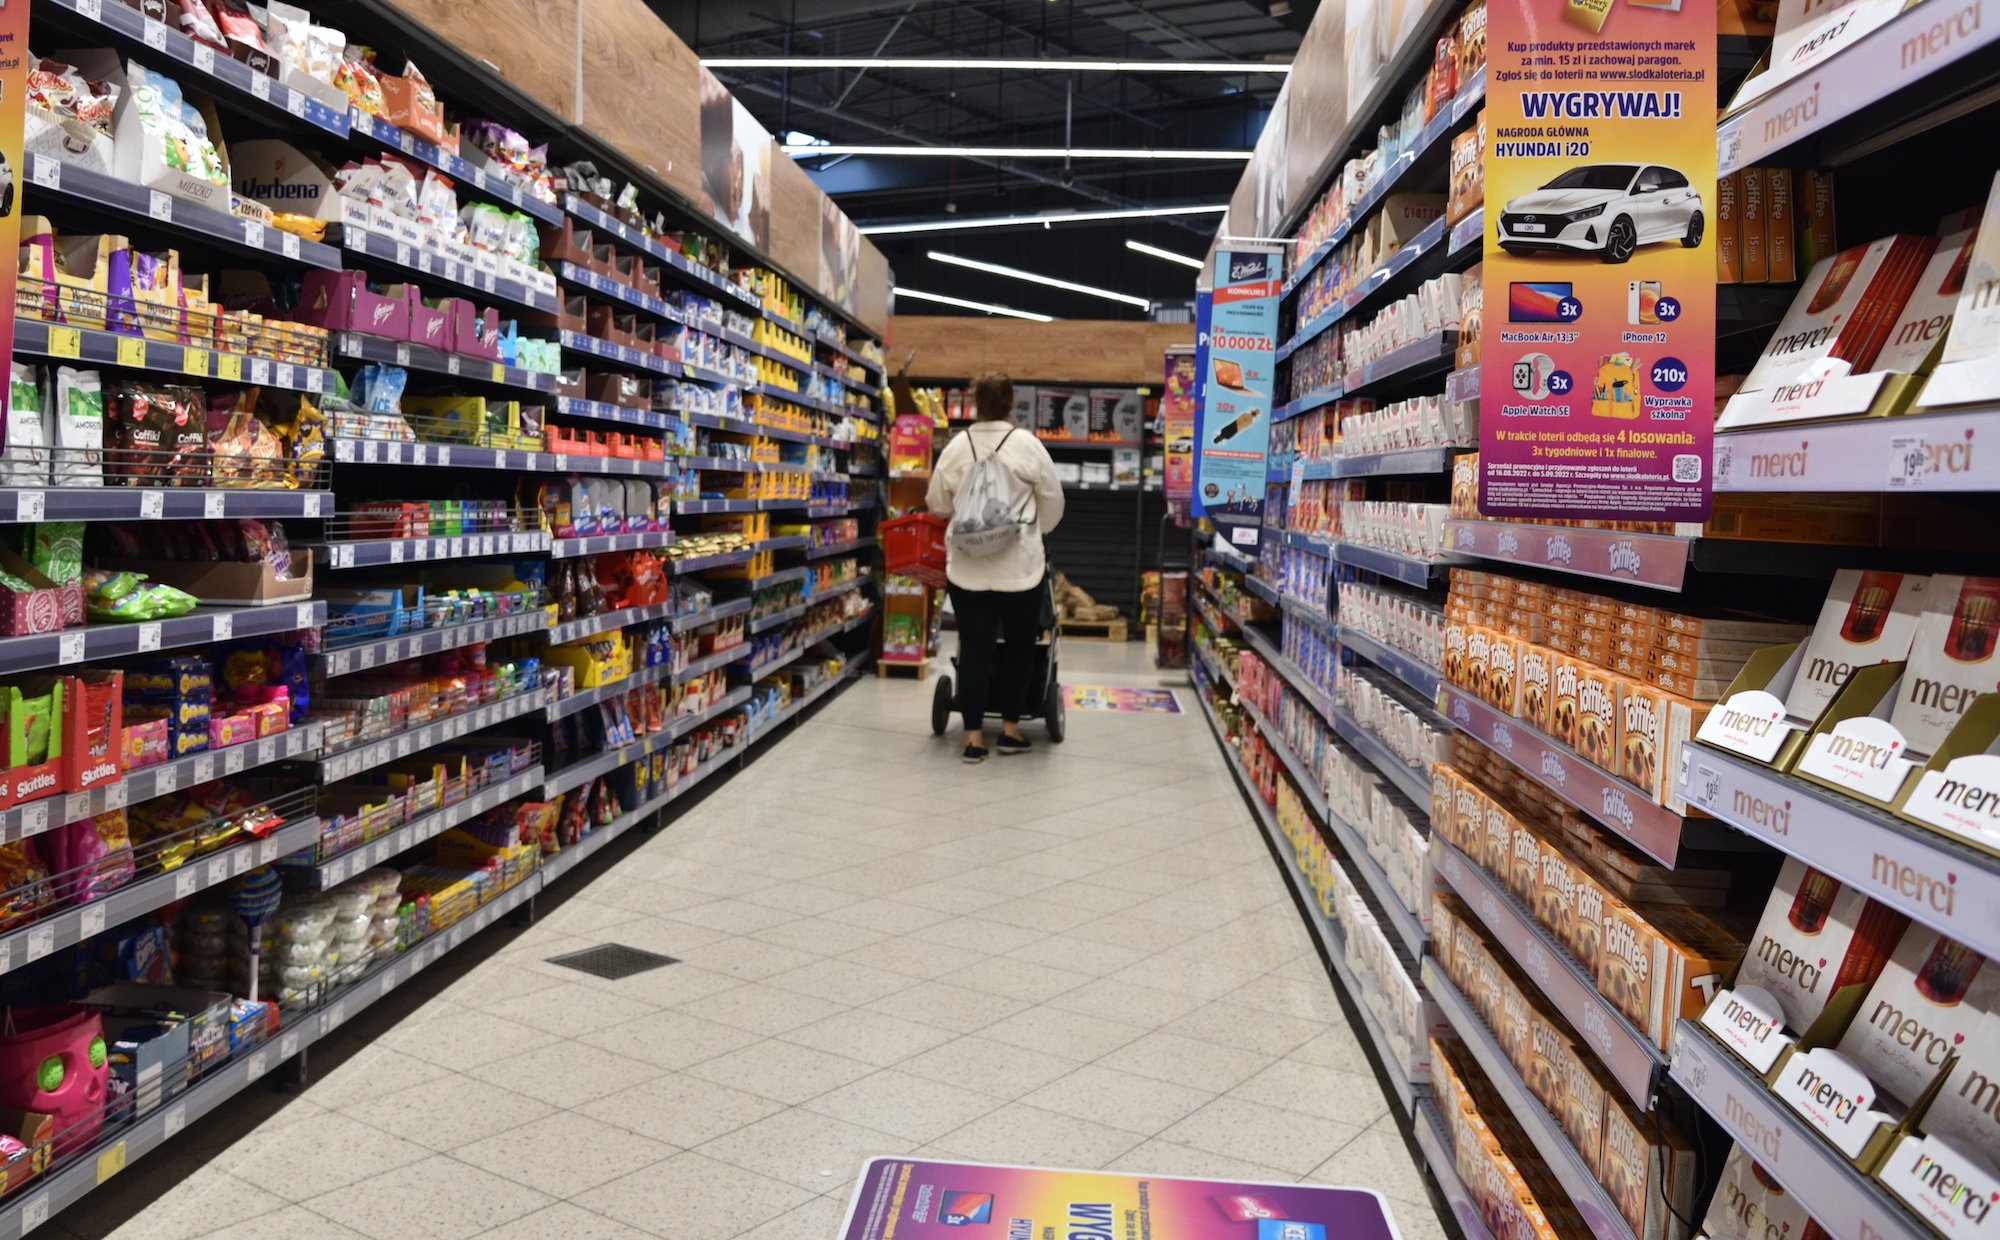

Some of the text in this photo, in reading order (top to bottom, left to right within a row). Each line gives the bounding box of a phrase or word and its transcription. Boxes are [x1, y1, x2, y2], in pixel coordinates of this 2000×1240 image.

[1508, 40, 1696, 52] Kup produkty przedstawionych marek
[1792, 10, 1856, 61] merci
[1901, 1, 1981, 70] merci
[1496, 70, 1522, 81] Zgłoś
[1524, 71, 1537, 81] się
[1540, 70, 1552, 79] do
[1555, 69, 1583, 79] loterii
[1600, 69, 1704, 81] www.slodkaloteria.pl
[1521, 58, 1532, 66] za
[1534, 56, 1556, 65] min.
[1558, 55, 1570, 64] 15
[1589, 55, 1635, 66] zachowaj
[1638, 56, 1681, 66] paragon.
[1522, 92, 1681, 118] WYGRYWAJ!
[1764, 82, 1821, 143] merci
[1497, 126, 1589, 137] NAGRODA GŁÓWNA
[1496, 143, 1561, 157] HYUNDAI
[177, 179, 214, 199] MIESZKO
[242, 178, 318, 199] Verbena
[1745, 172, 1760, 220] Toffifee
[1771, 172, 1786, 219] Toffifee
[1227, 288, 1265, 296] KONKURS
[1561, 303, 1577, 315] 3x
[1659, 303, 1675, 315] 3x
[1228, 336, 1255, 350] 000
[1502, 332, 1539, 342] MacBook
[1542, 333, 1554, 342] Air
[1623, 333, 1666, 343] iPhone 12
[1770, 314, 1841, 357] merci
[1551, 377, 1568, 390] 3x
[1653, 368, 1686, 383] 210x
[1771, 369, 1830, 403] merci
[372, 397, 391, 412] ICE
[1502, 406, 1570, 416] Apple Watch SE
[1645, 397, 1692, 408] Wyprawka
[133, 429, 161, 442] Coffiki
[1496, 430, 1696, 444] W trakcie loterii odbędą się 4 losowania:
[1532, 446, 1543, 456] 3x
[1545, 447, 1598, 458] tygodniowe
[1605, 448, 1614, 457] 1x
[1750, 441, 1808, 478] merci
[1498, 530, 1517, 556] Toffifee
[1546, 534, 1571, 564] Toffifee
[1608, 539, 1641, 577] Toffifee
[1490, 642, 1514, 678] Toffifee
[1523, 652, 1549, 693] Toffifee
[1556, 666, 1577, 697] Toffi
[1910, 677, 1977, 715] mer
[1578, 678, 1613, 726] Toffifee
[1492, 722, 1512, 752] Toffifee
[1718, 708, 1778, 738] merci
[1541, 750, 1566, 787] Toffifee
[1826, 734, 1899, 770] merci
[17, 772, 56, 798] Skittles
[81, 764, 116, 786] Skittles
[1456, 790, 1481, 828] Toffifee
[1602, 787, 1634, 831] Toffifee
[1732, 789, 1792, 836] merci
[1487, 809, 1510, 851] Toffifee
[1513, 830, 1539, 870] Toffife
[1872, 852, 1957, 917] merci
[1603, 916, 1648, 983] Toffifee
[1757, 936, 1827, 994] merci
[1504, 986, 1528, 1040] Toffifee
[1584, 1002, 1612, 1056] Toffifee
[1722, 999, 1778, 1043] merci
[1869, 1000, 1964, 1070] merci
[1568, 1062, 1600, 1129] Toffifee
[1797, 1067, 1864, 1125] merci
[1725, 1092, 1782, 1164] merci
[1608, 1110, 1644, 1186] Toffifee
[1910, 1153, 2000, 1226] merci
